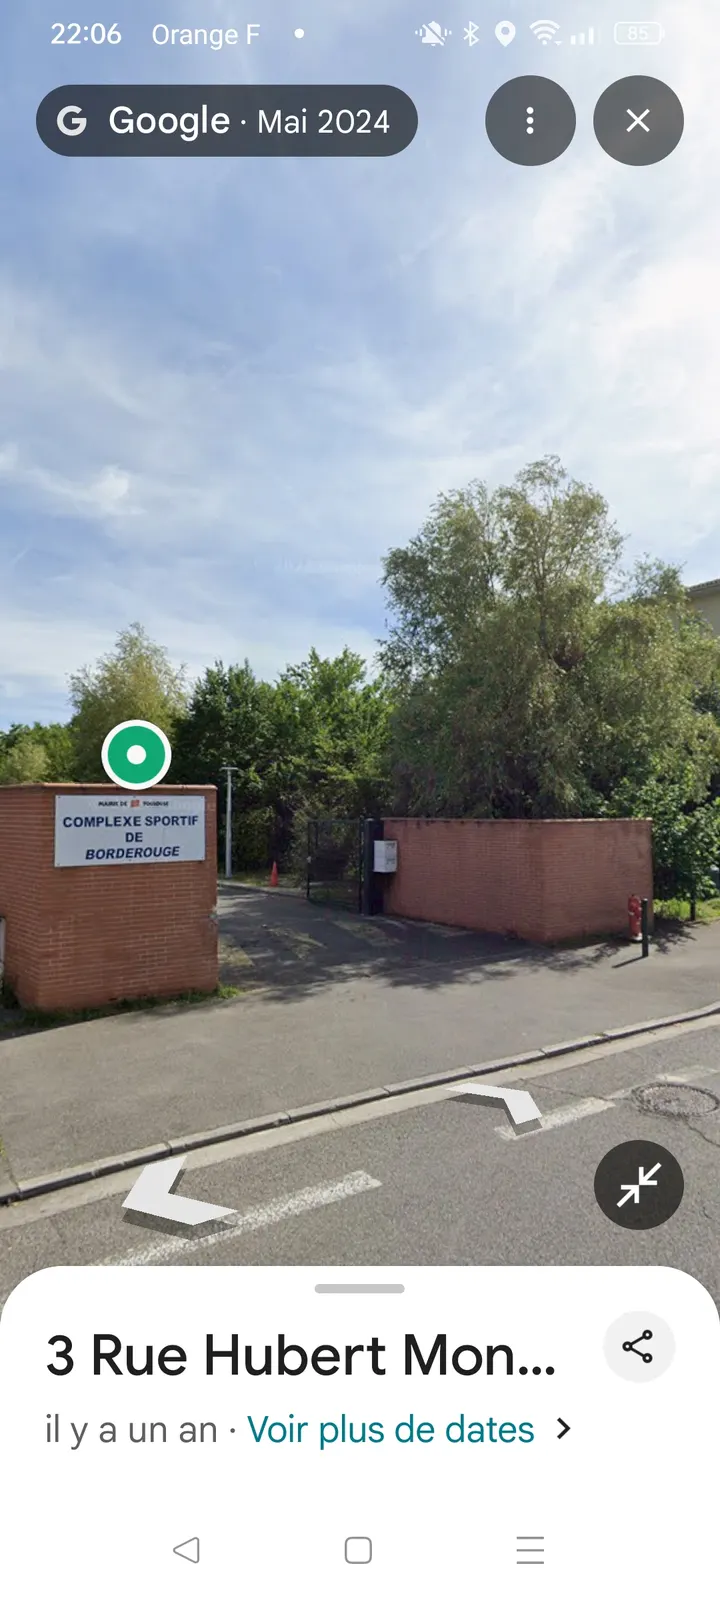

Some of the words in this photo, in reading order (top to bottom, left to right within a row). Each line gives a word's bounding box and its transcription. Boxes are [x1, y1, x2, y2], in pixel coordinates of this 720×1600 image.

[62, 815, 142, 828] COMPLEXE
[144, 815, 199, 827] SPORTIF
[125, 831, 143, 843] DE
[85, 846, 180, 860] BORDEROUGE
